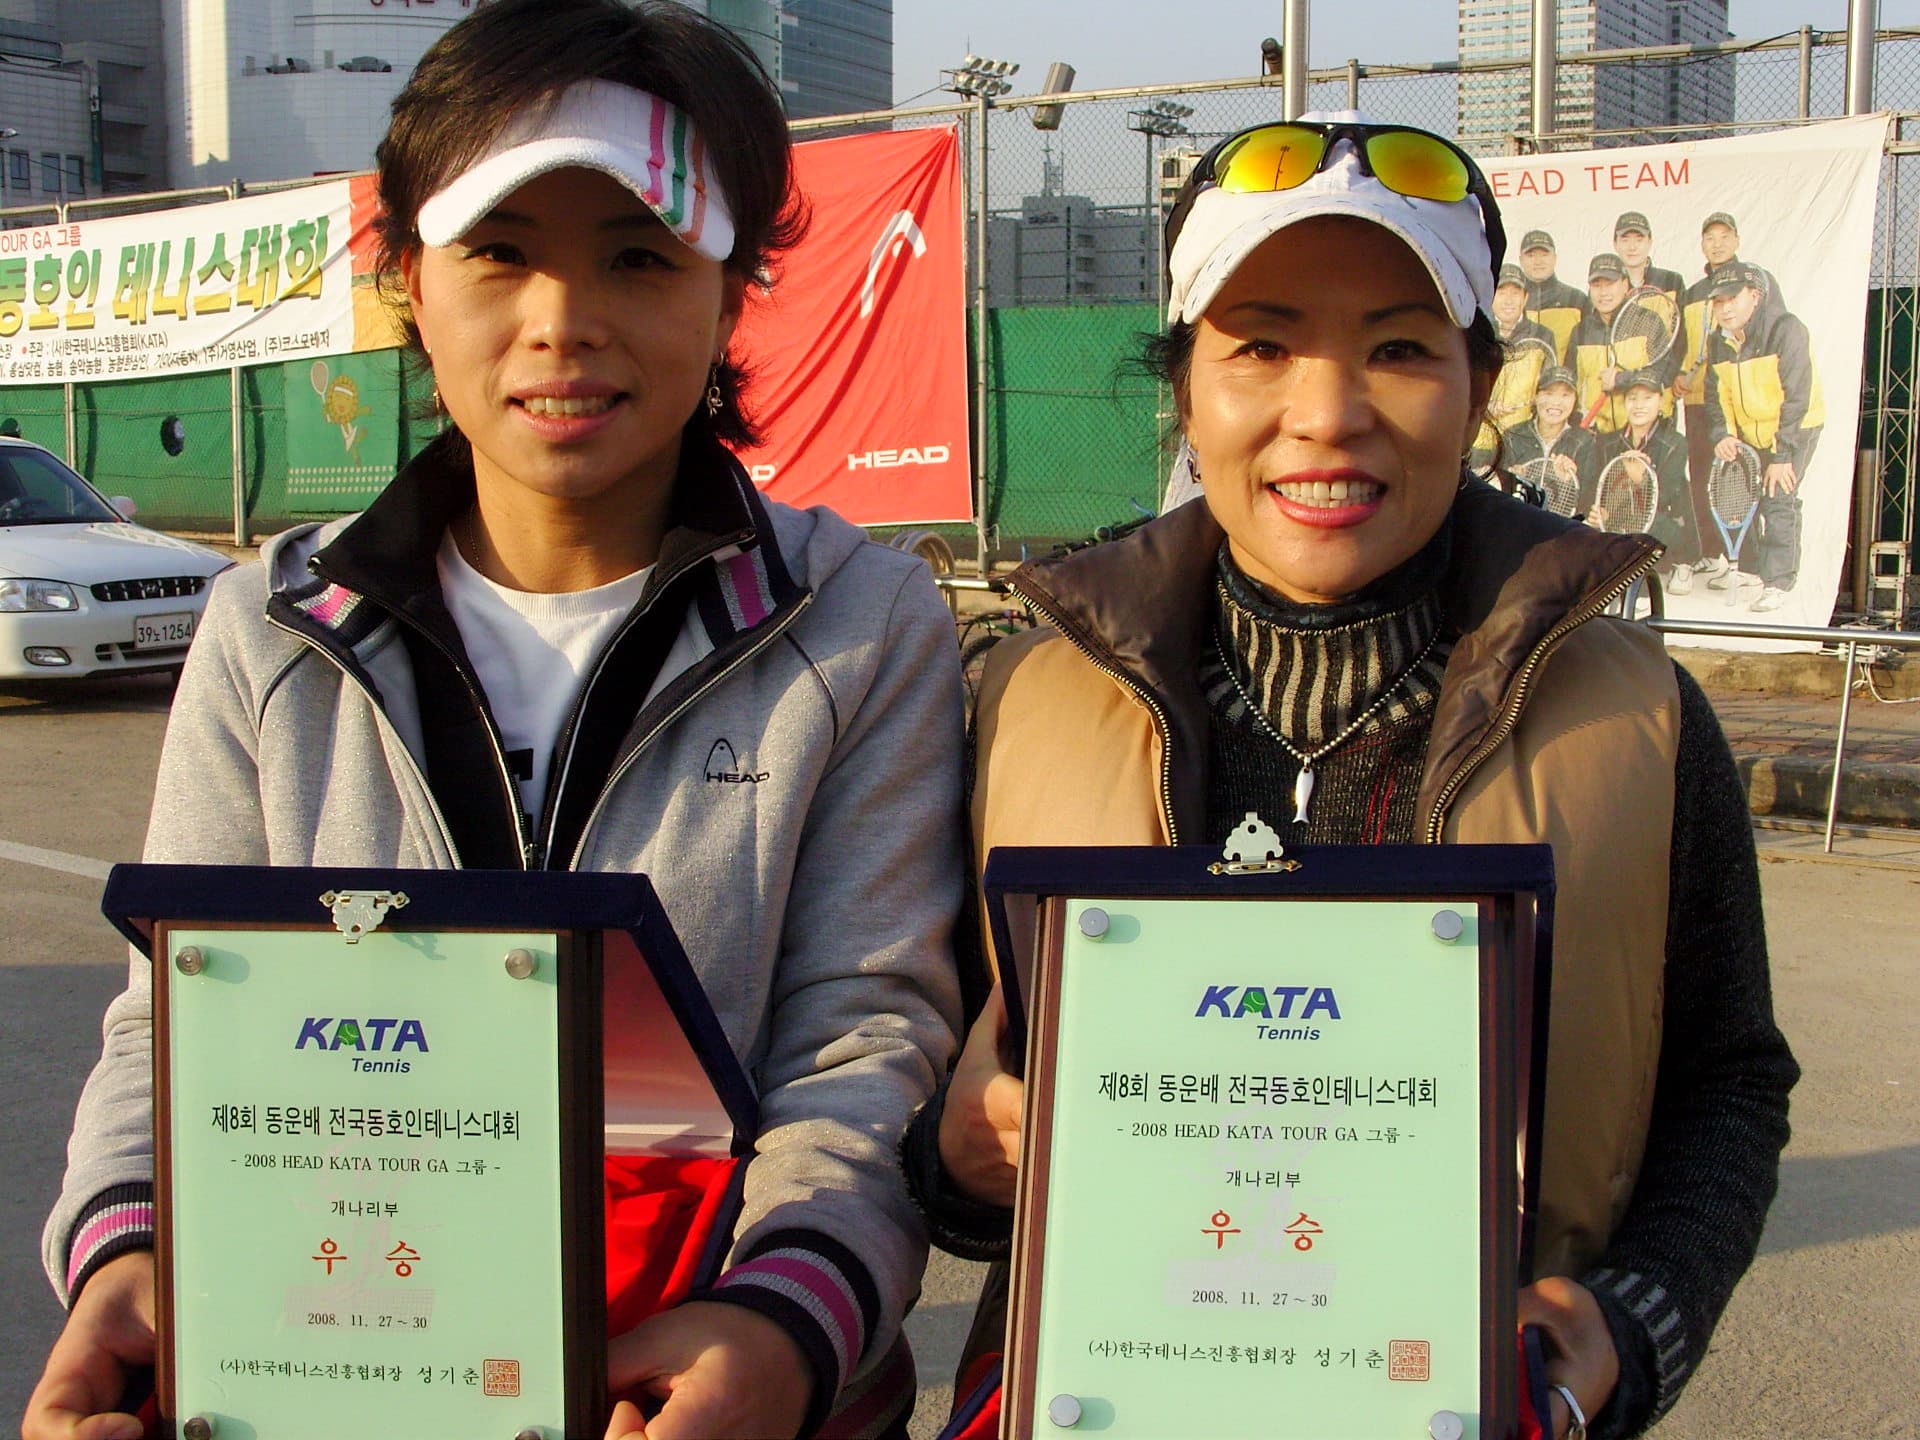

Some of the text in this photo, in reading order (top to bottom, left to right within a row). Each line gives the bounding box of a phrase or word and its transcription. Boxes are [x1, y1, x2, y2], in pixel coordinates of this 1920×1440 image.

[1491, 158, 1689, 198] EAD TEAM
[0, 225, 82, 253] OUR GA 그룹
[0, 214, 330, 338] 동호인 테니스대회
[848, 445, 950, 470] HEAD
[706, 771, 770, 783] HEAD
[1195, 986, 1341, 1019] KATA
[295, 1018, 429, 1052] KATA
[1257, 1025, 1320, 1041] Tennis
[351, 1057, 411, 1074] Tennis
[1099, 1071, 1437, 1108] 제8회 동운배 전국동호인테니스대회
[211, 1103, 520, 1141] 제8회 동운배 전국동호인테니스대회
[1131, 1122, 1168, 1137] 2008
[1175, 1123, 1220, 1139] HEAD
[1227, 1124, 1274, 1140] KATA
[1280, 1126, 1327, 1141] TOUR
[1334, 1127, 1359, 1142] GA
[1366, 1127, 1401, 1144] 그룹
[244, 1154, 277, 1168] 2008
[282, 1154, 324, 1169] HEAD
[329, 1156, 372, 1171] KATA
[378, 1157, 421, 1172] TOUR
[427, 1158, 449, 1173] GA
[456, 1159, 488, 1176] 그룹
[1226, 1169, 1301, 1189] 개나리부
[331, 1199, 399, 1218] 개나리부
[1192, 1290, 1228, 1304] 2008.
[307, 1313, 340, 1326] 2008.
[1088, 1340, 1297, 1366] (사)한국테니스진흥협회장
[220, 1359, 403, 1382] (사)한국테니스진흥협회장
